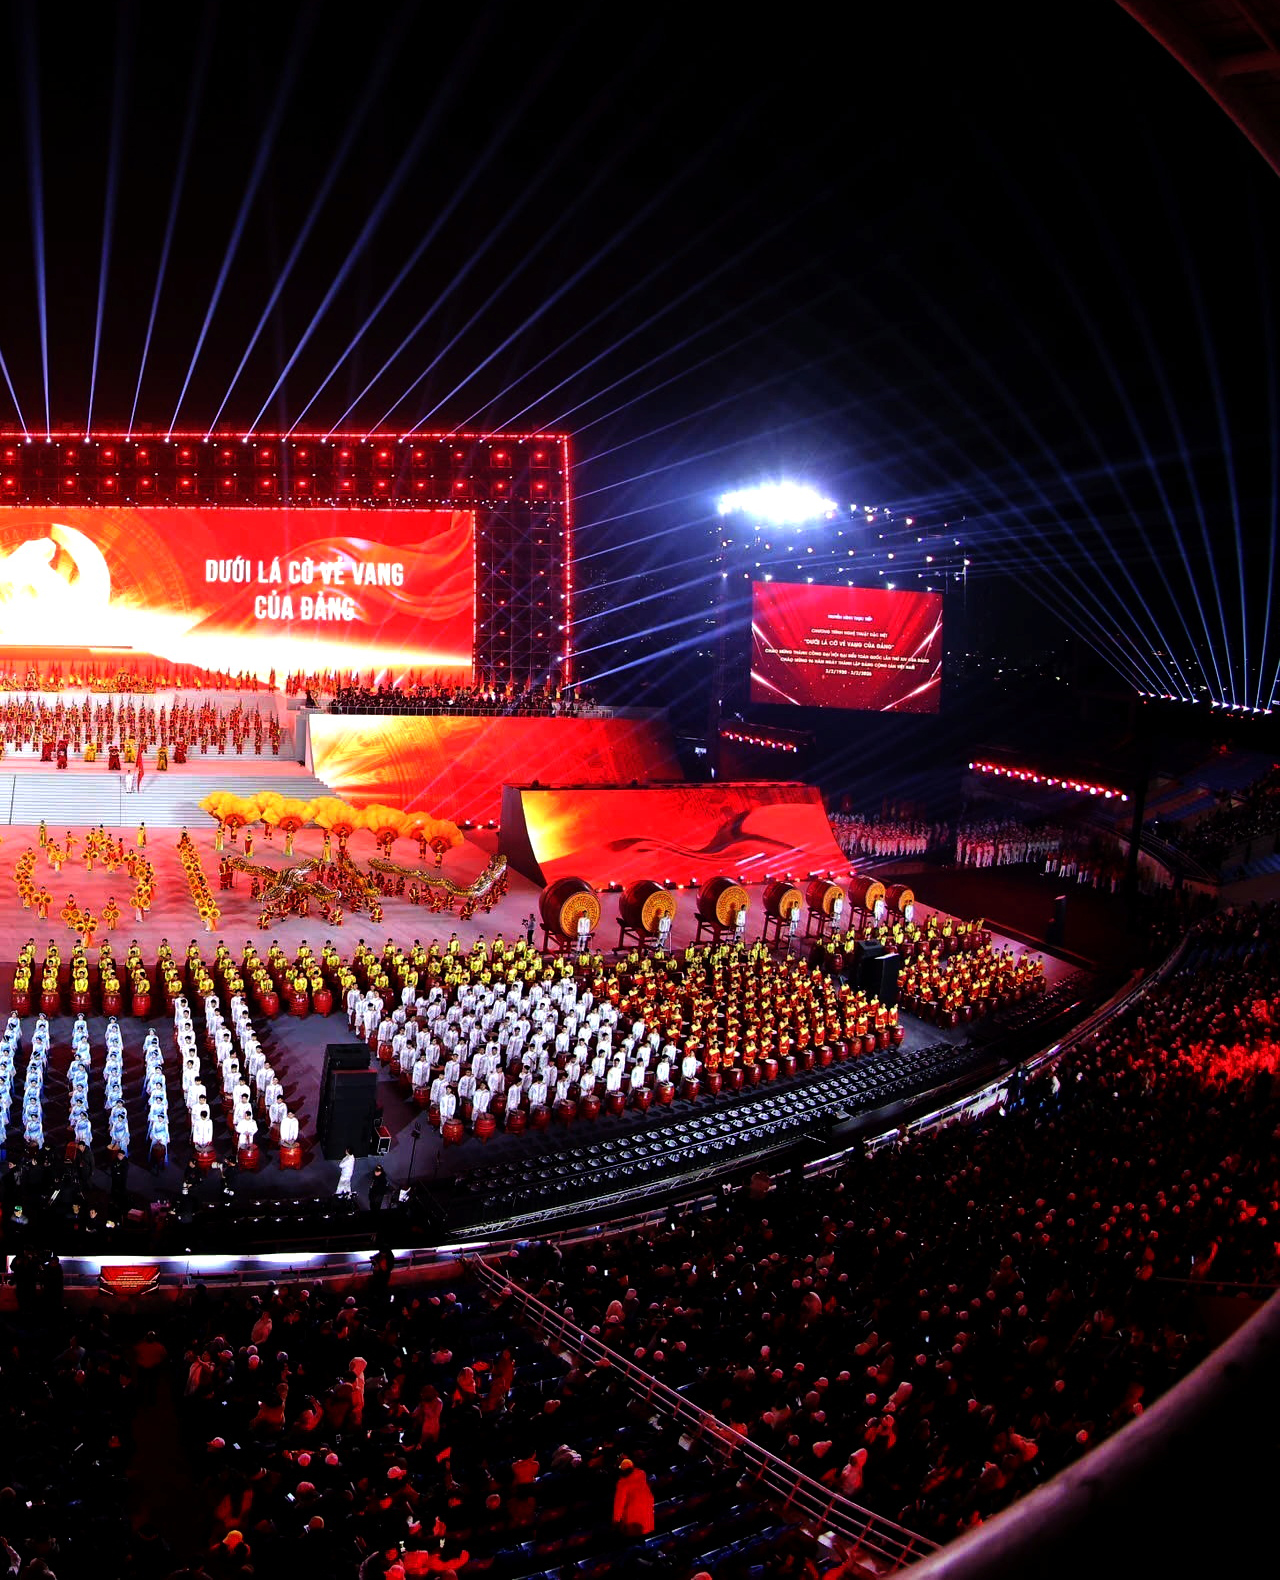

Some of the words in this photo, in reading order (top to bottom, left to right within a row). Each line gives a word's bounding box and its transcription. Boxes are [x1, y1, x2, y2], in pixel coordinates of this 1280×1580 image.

[205, 555, 251, 583] DƯỚI
[258, 556, 282, 584] LÁ
[288, 557, 314, 584] CỜ
[353, 562, 404, 586] VANG
[254, 590, 295, 620] CỦA
[299, 590, 354, 621] ĐẢNG
